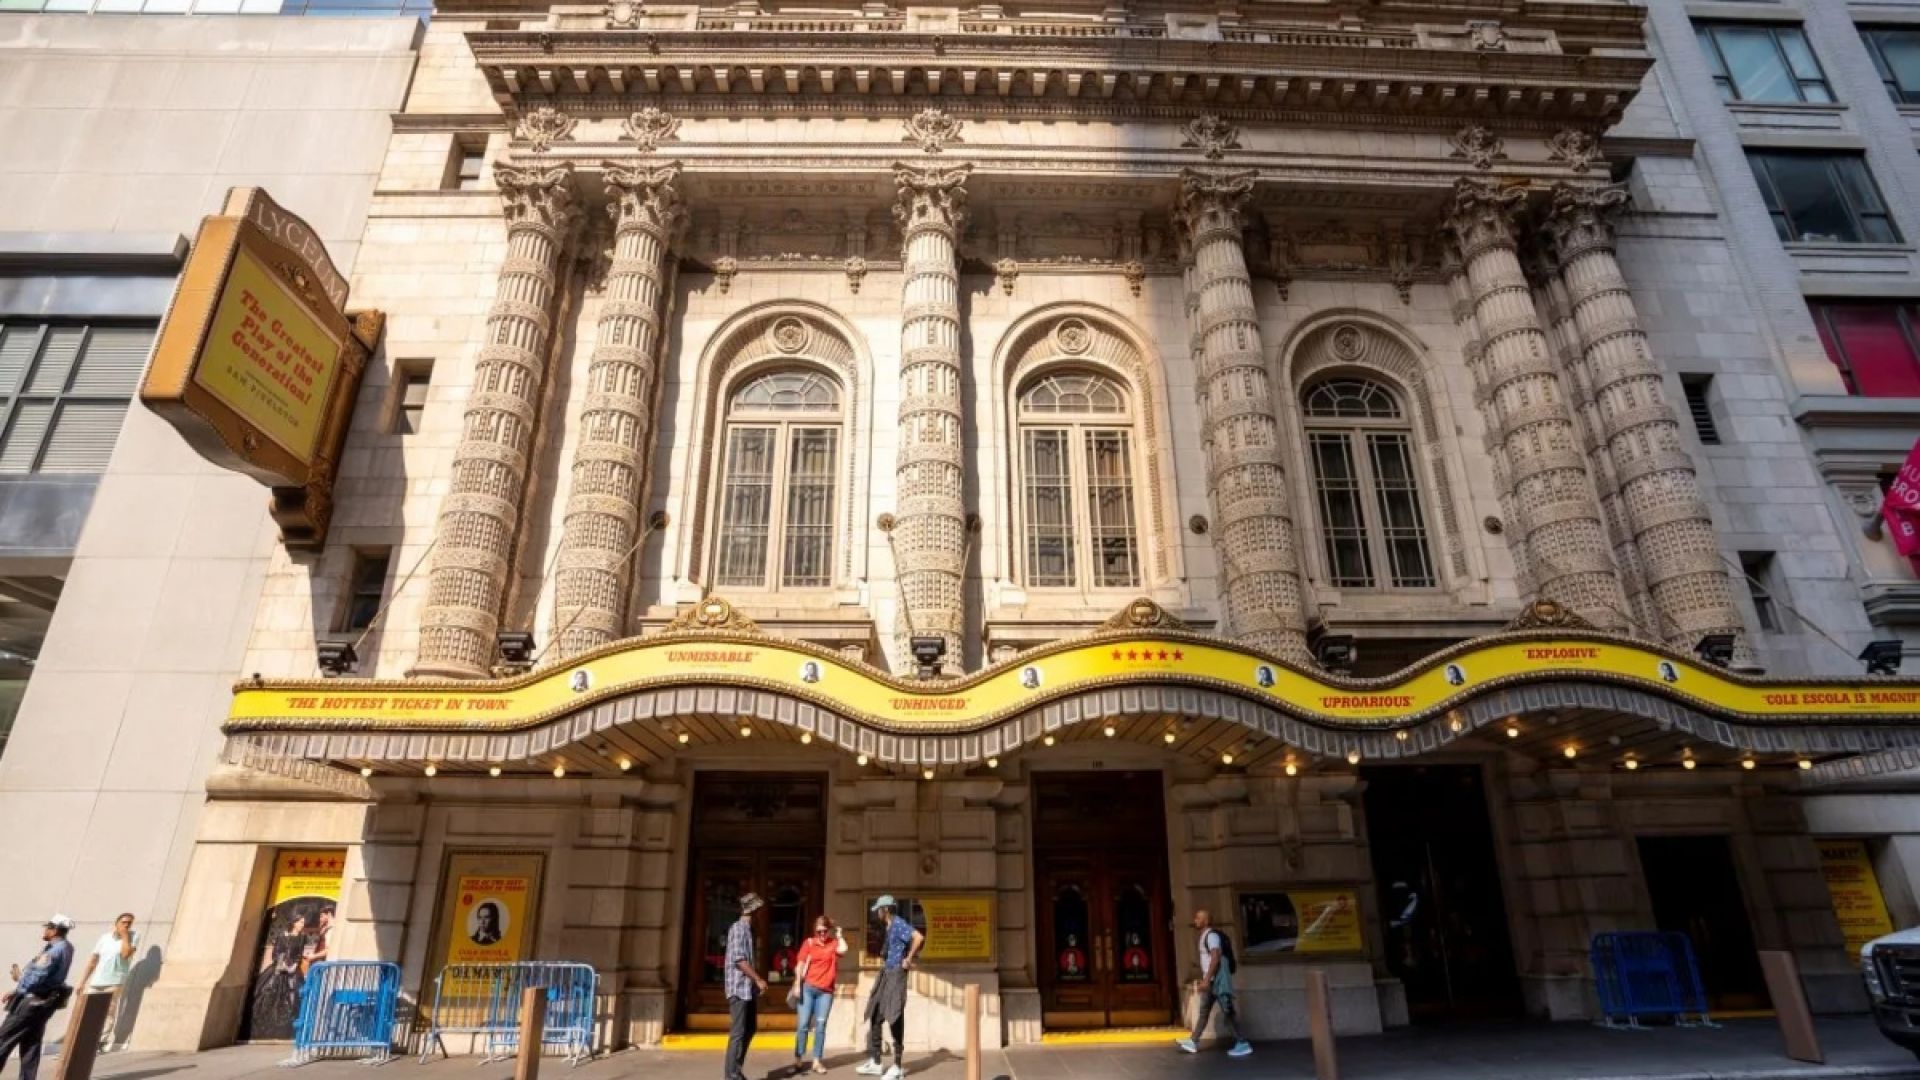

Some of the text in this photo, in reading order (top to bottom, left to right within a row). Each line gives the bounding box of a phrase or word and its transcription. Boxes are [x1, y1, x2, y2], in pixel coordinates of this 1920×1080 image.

[257, 202, 343, 312] LYCEUM
[231, 330, 312, 405] Generation!
[241, 315, 313, 386] Play of the
[242, 289, 324, 374] The Greatest
[320, 697, 387, 710] HOTTEST
[391, 698, 443, 710] TICKET
[445, 698, 462, 710] IN
[1803, 692, 1850, 704] ESCOLA
[1855, 692, 1867, 704] IS
